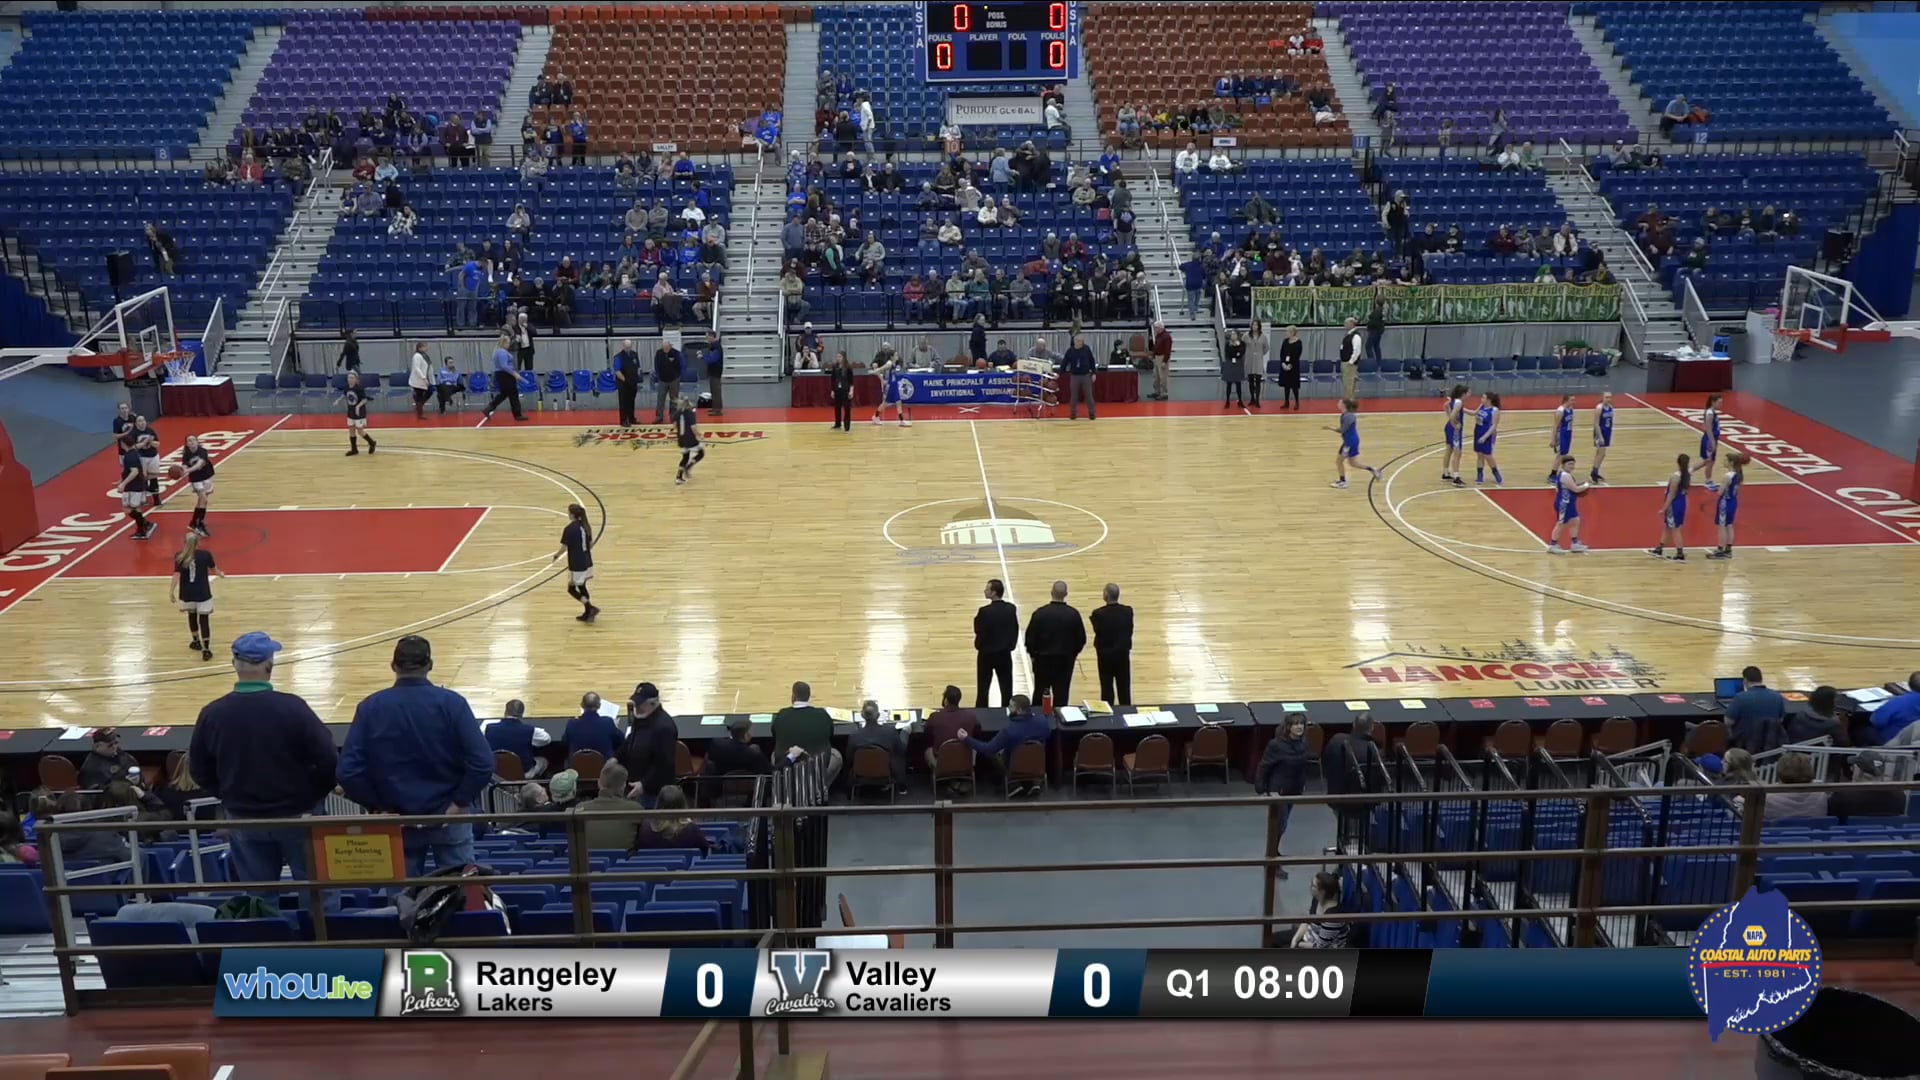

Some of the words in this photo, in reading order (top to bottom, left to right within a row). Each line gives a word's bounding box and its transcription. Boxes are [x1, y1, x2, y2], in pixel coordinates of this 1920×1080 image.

[954, 4, 968, 30] 0
[1050, 3, 1064, 29] 0
[928, 34, 952, 42] FOULS
[969, 33, 998, 41] PLAYER
[1041, 32, 1065, 40] FOULS
[937, 43, 951, 69] 0
[1050, 41, 1064, 68] 0
[956, 104, 998, 115] PURDUE
[931, 389, 975, 397] INVITATIONAL
[0, 512, 126, 572] CIVIC
[1359, 661, 1628, 683] HANCOCK
[1514, 678, 1660, 692] LUMBER
[335, 848, 353, 856] Keep
[354, 847, 382, 856] Moving
